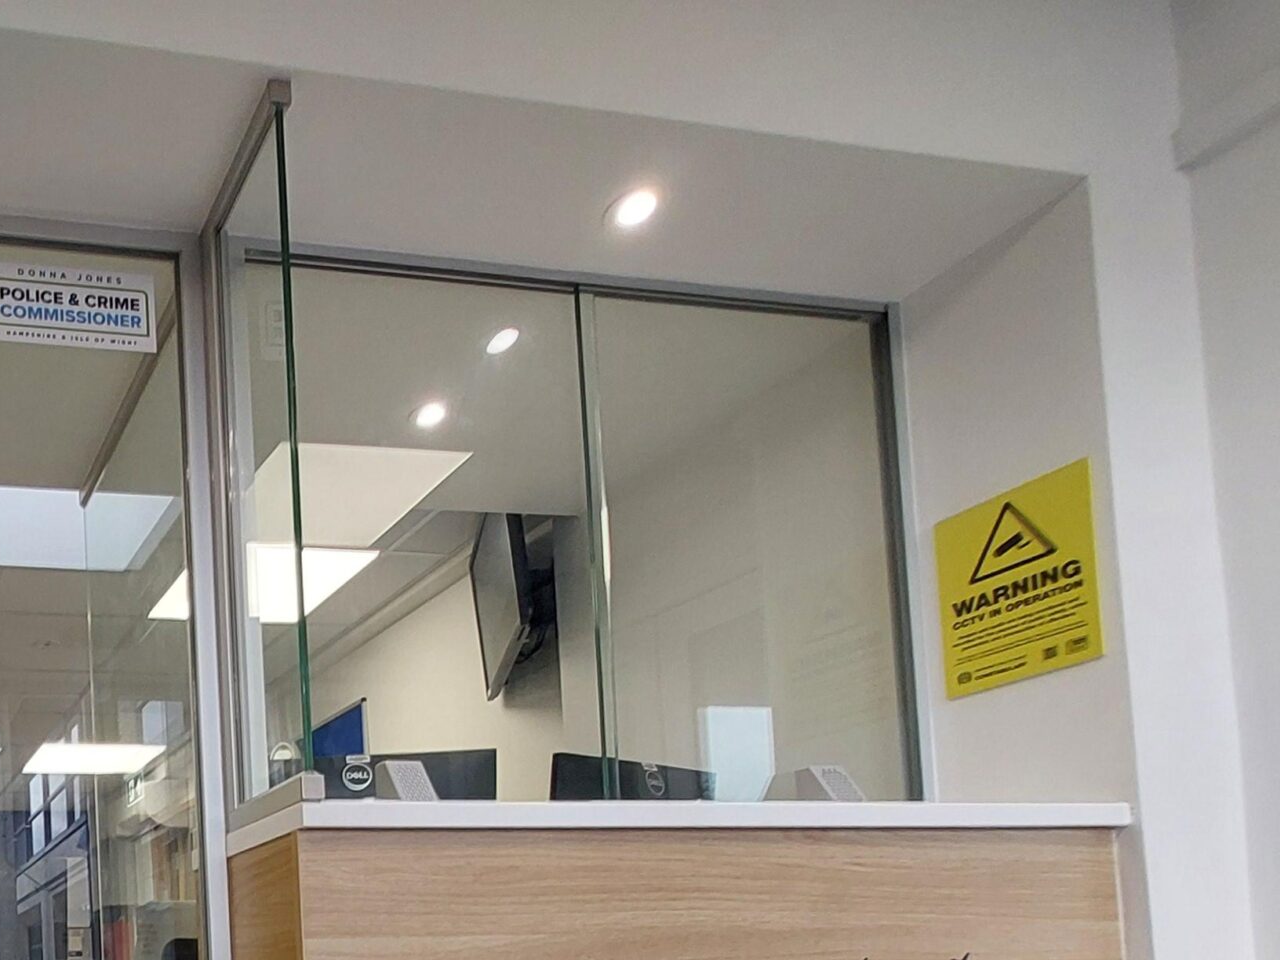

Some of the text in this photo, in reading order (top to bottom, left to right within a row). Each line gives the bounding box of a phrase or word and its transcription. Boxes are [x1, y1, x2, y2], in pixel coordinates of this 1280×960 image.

[17, 268, 122, 285] DONNA JONES
[0, 286, 140, 312] POLICE & CRIME
[0, 304, 141, 328] COMMISSIONER
[952, 559, 1083, 618] WARNING
[952, 579, 1083, 631] CCTV IN OPERATION
[346, 771, 368, 780] DELL
